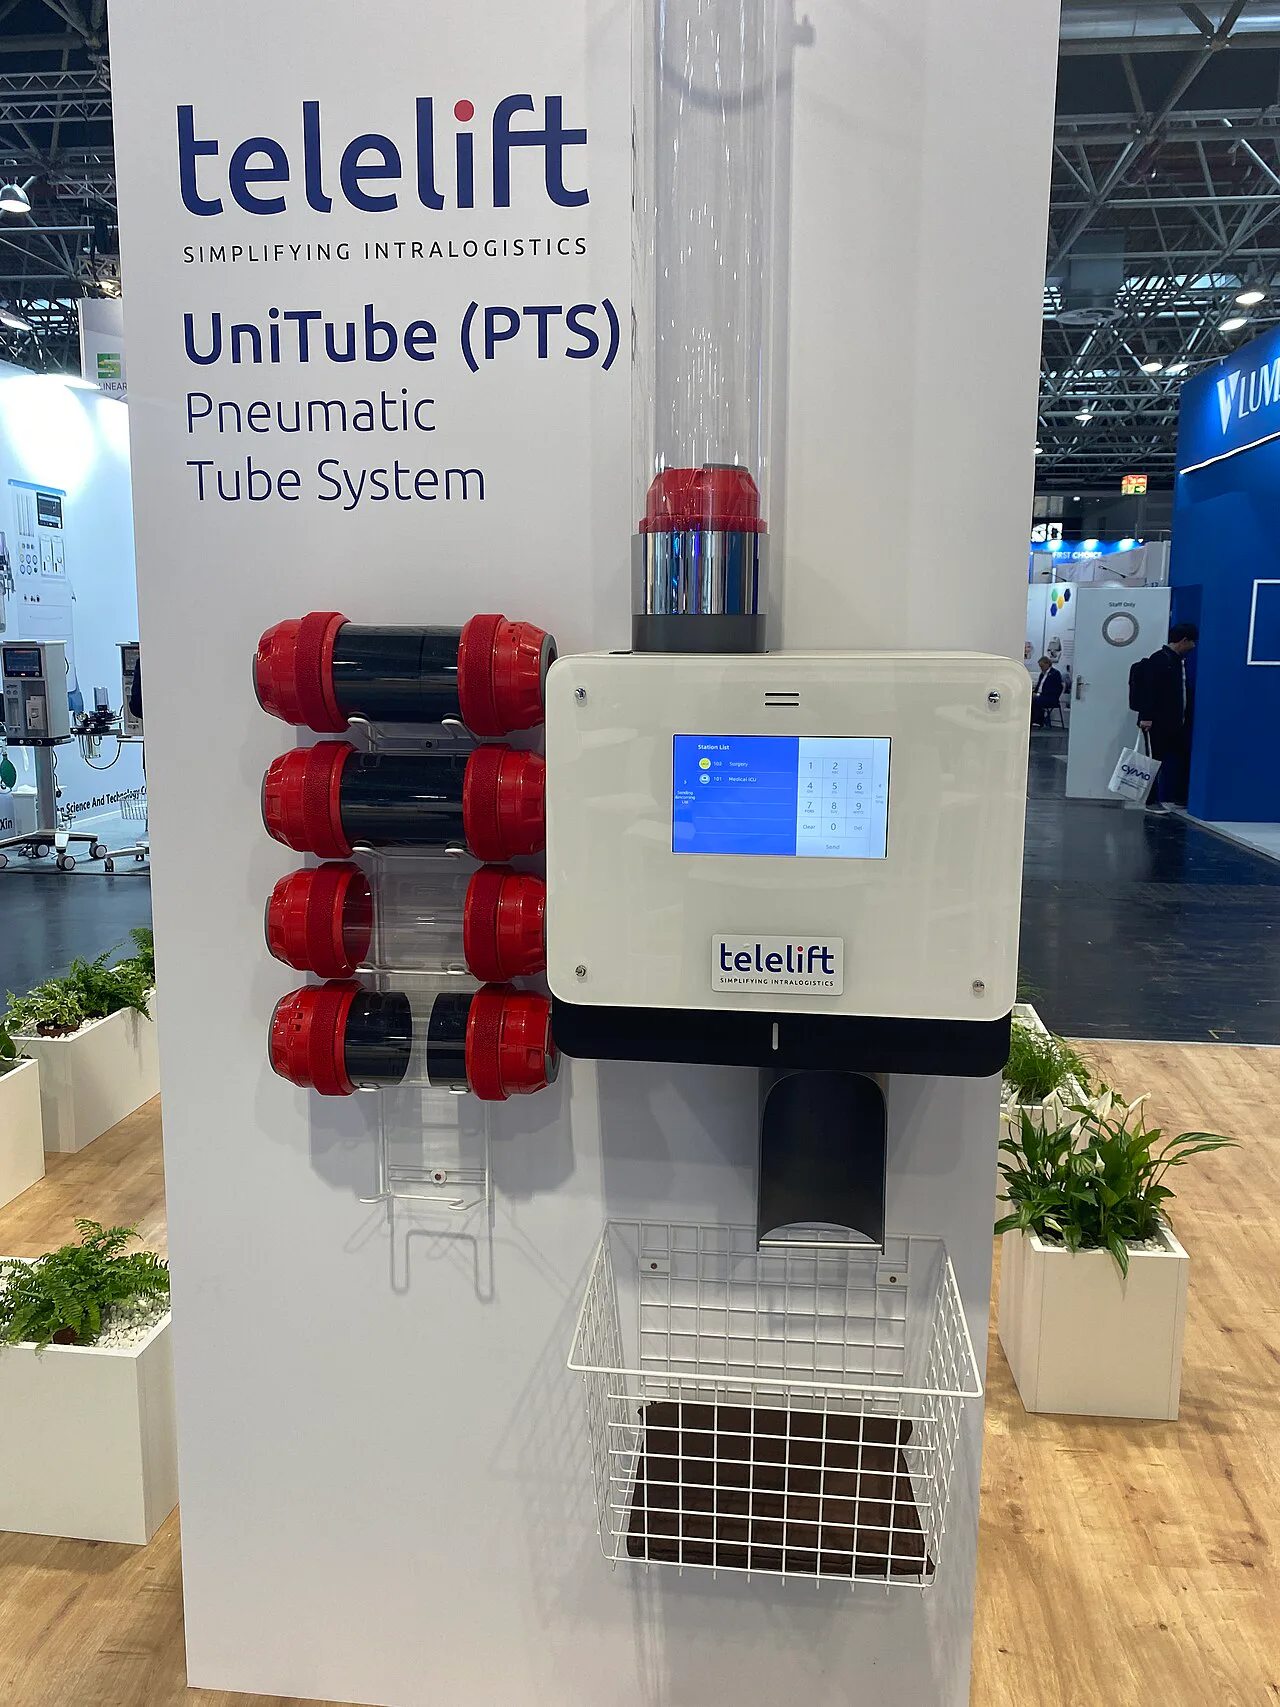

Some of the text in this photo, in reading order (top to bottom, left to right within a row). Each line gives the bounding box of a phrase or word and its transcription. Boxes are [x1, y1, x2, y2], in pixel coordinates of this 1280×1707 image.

[176, 94, 590, 217] telelift
[183, 237, 588, 264] SIMPLIFYING INTRALOGISTICS
[183, 298, 621, 373] UniTube (PTS)
[186, 387, 436, 433] Pneumatic
[187, 455, 485, 511] Tube System
[808, 761, 813, 770] 1
[832, 762, 838, 770] 2
[857, 762, 863, 771] 3
[806, 781, 813, 790] 4
[832, 782, 838, 790] 5
[856, 782, 863, 791] 6
[66, 801, 91, 814] Science
[91, 795, 105, 807] And
[806, 801, 813, 809] 7
[831, 801, 837, 810] 8
[855, 802, 862, 810] 9
[830, 822, 837, 831] 0
[720, 943, 835, 974] telelift
[771, 979, 834, 987] INTRALOGISTICS
